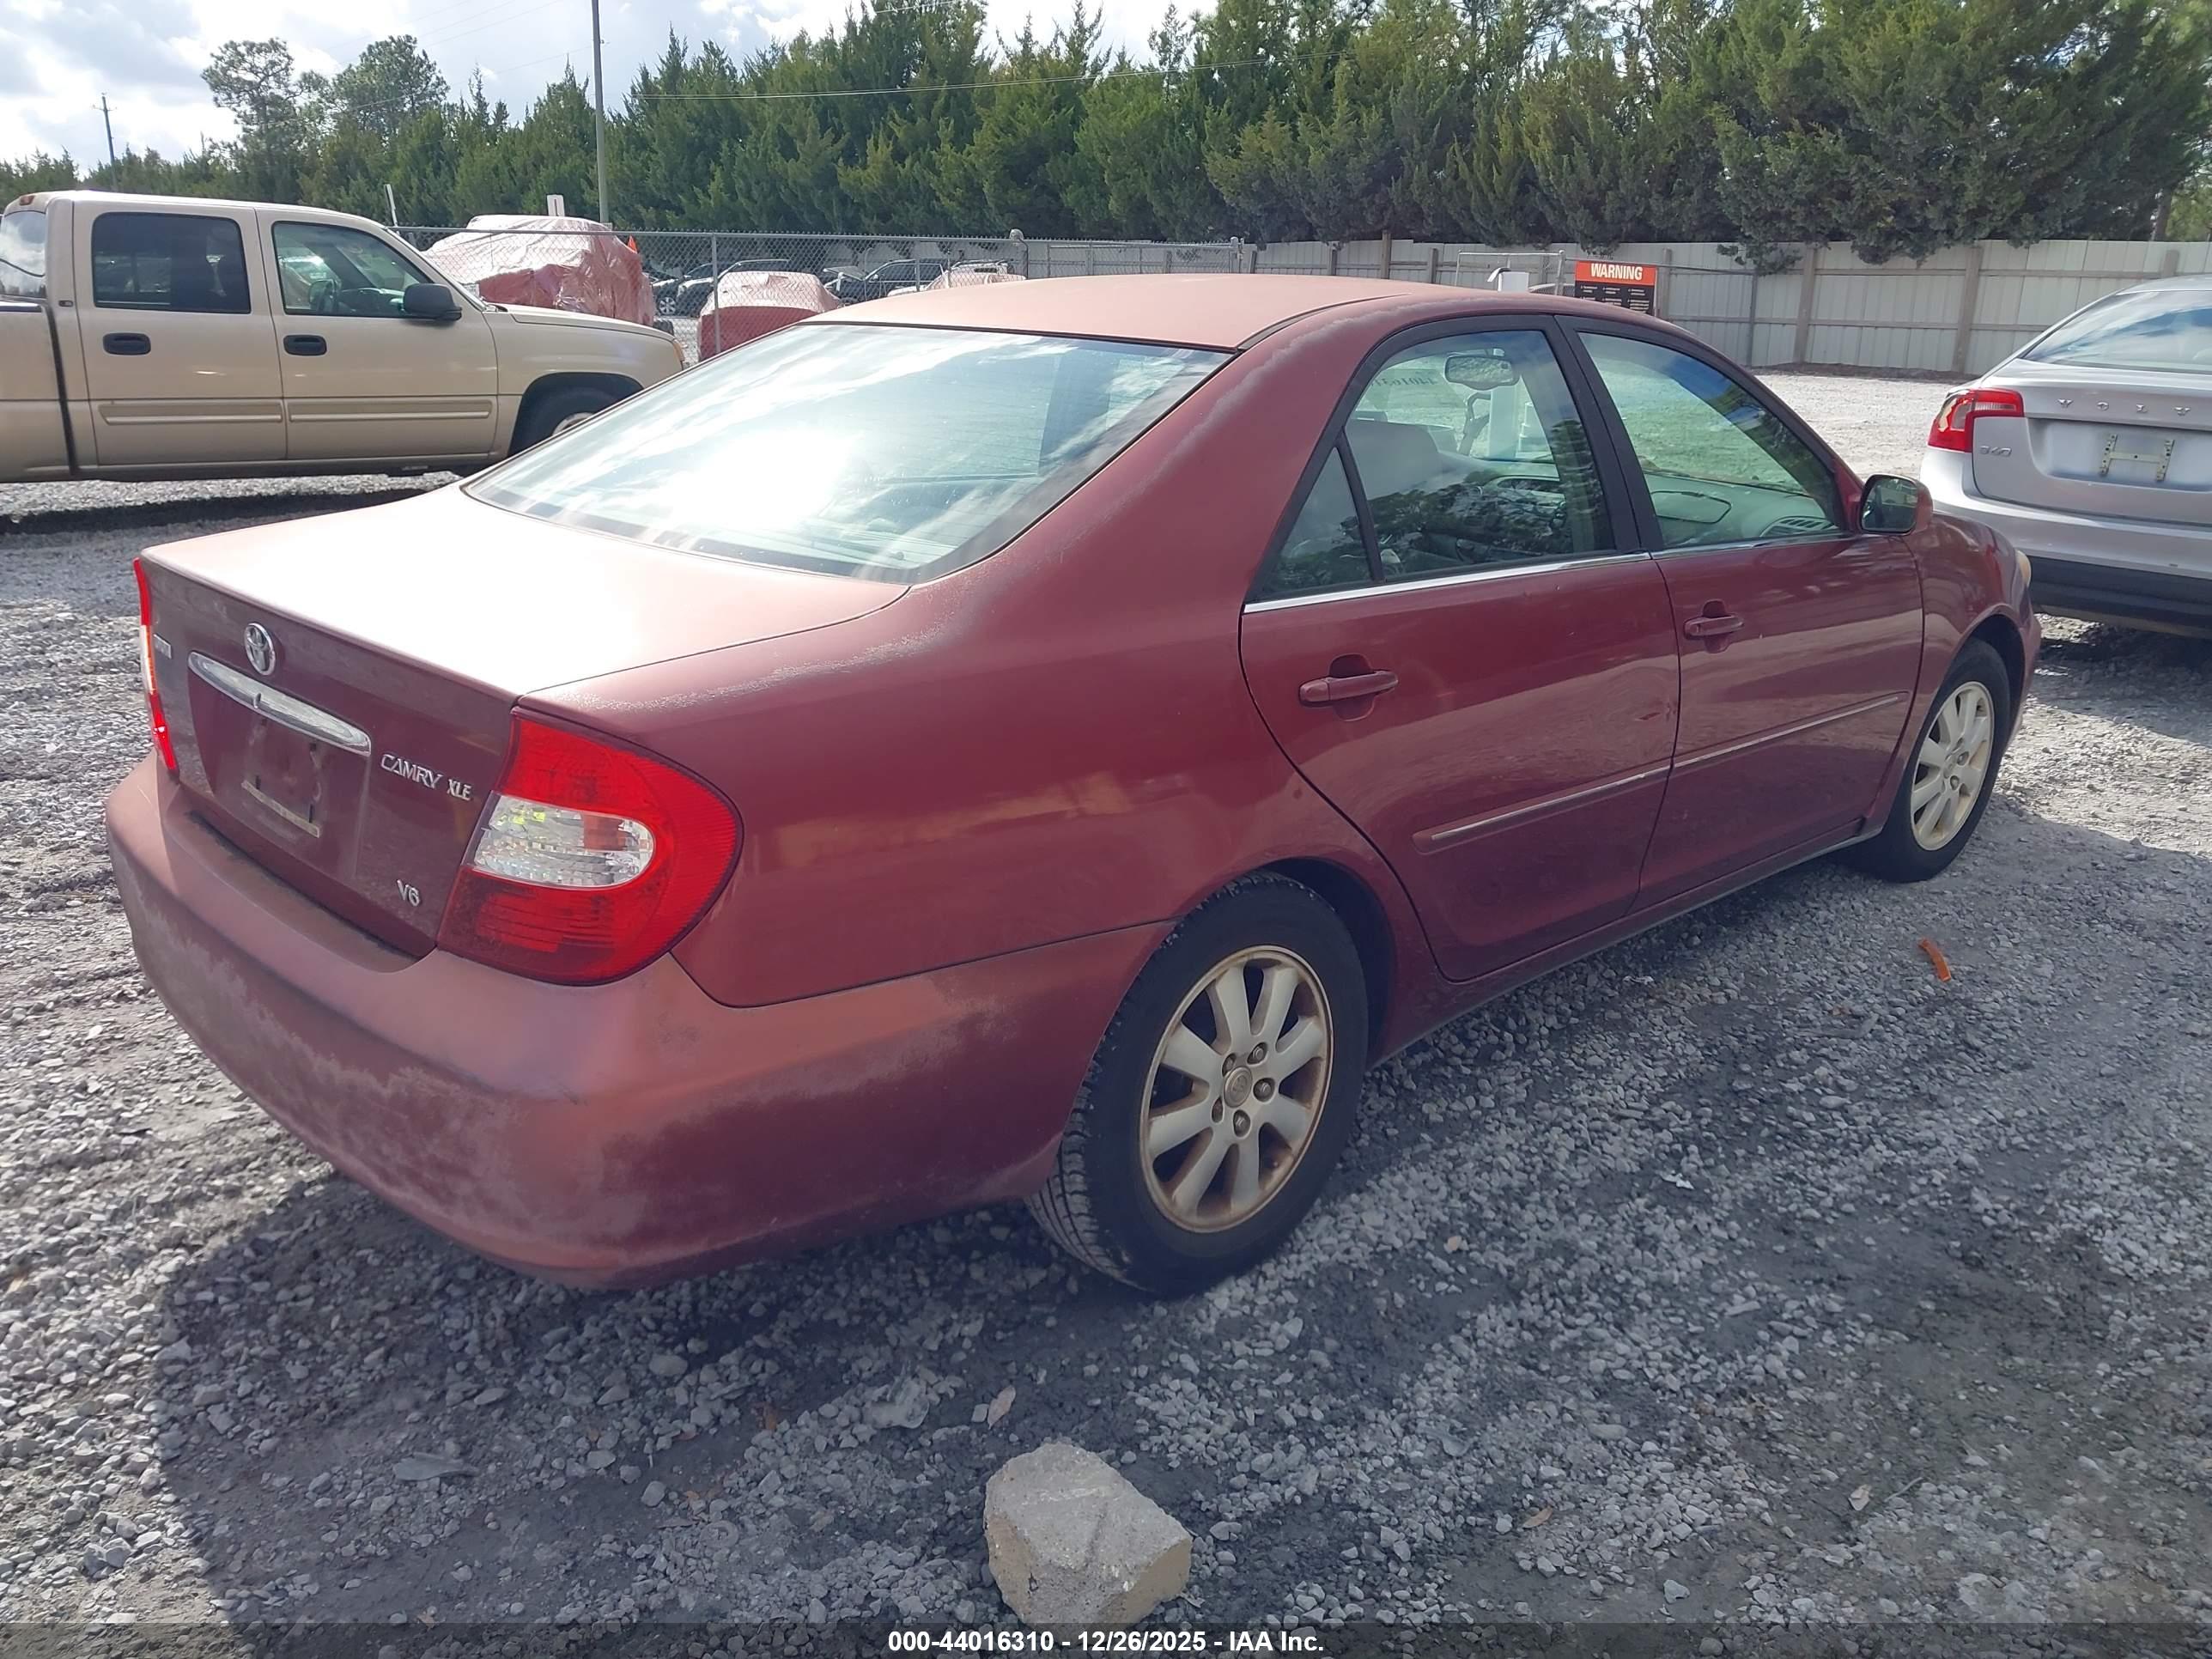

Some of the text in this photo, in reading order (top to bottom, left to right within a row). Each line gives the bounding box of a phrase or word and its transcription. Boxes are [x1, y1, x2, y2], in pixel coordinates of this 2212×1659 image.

[1590, 263, 1644, 281] WARNING
[2057, 398, 2191, 416] VOLV
[380, 754, 472, 801] CAMRY XLE
[396, 879, 420, 907] V6
